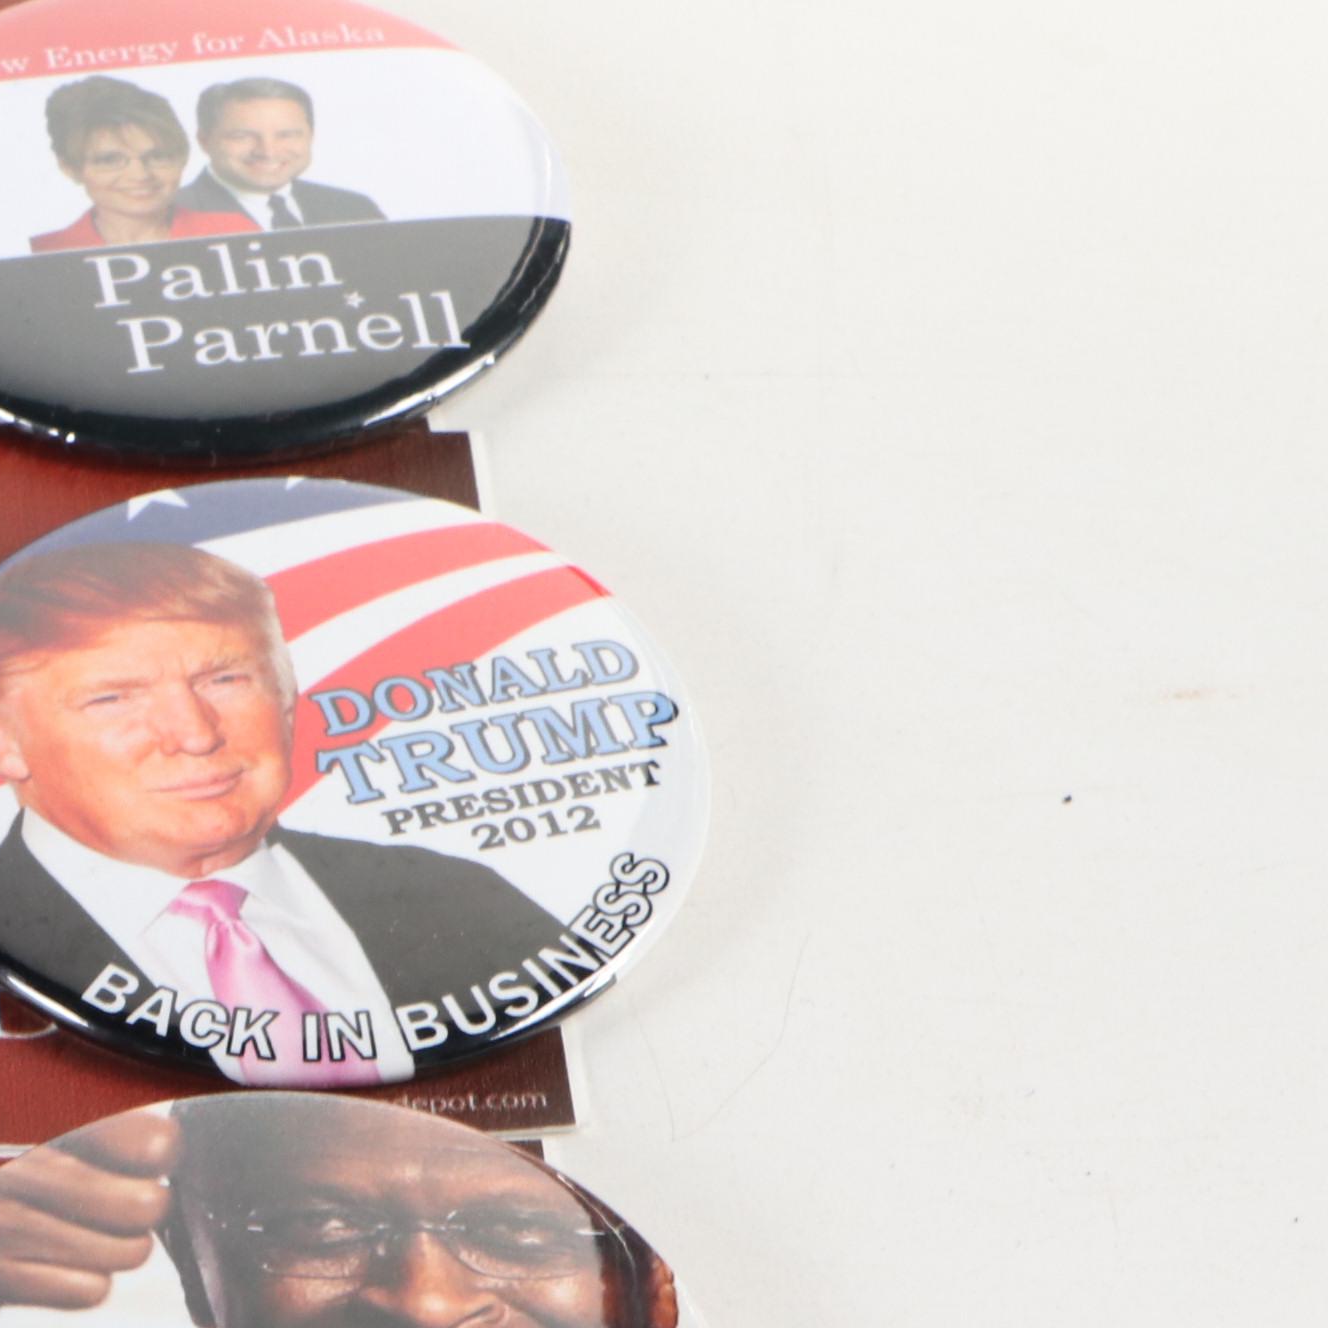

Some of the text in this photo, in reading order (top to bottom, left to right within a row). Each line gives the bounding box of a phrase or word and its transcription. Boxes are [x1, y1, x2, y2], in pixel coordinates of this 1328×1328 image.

[45, 38, 178, 71] Energy
[193, 32, 244, 55] for
[258, 23, 385, 50] Alaska
[84, 242, 343, 309] Palin
[117, 290, 471, 374] Parnell
[308, 640, 639, 736] DONALD
[316, 691, 679, 805] TRUMP
[381, 759, 660, 836] PRESIDENT
[471, 804, 601, 851] 2012
[80, 852, 670, 1062] BACK IN BUSINESS
